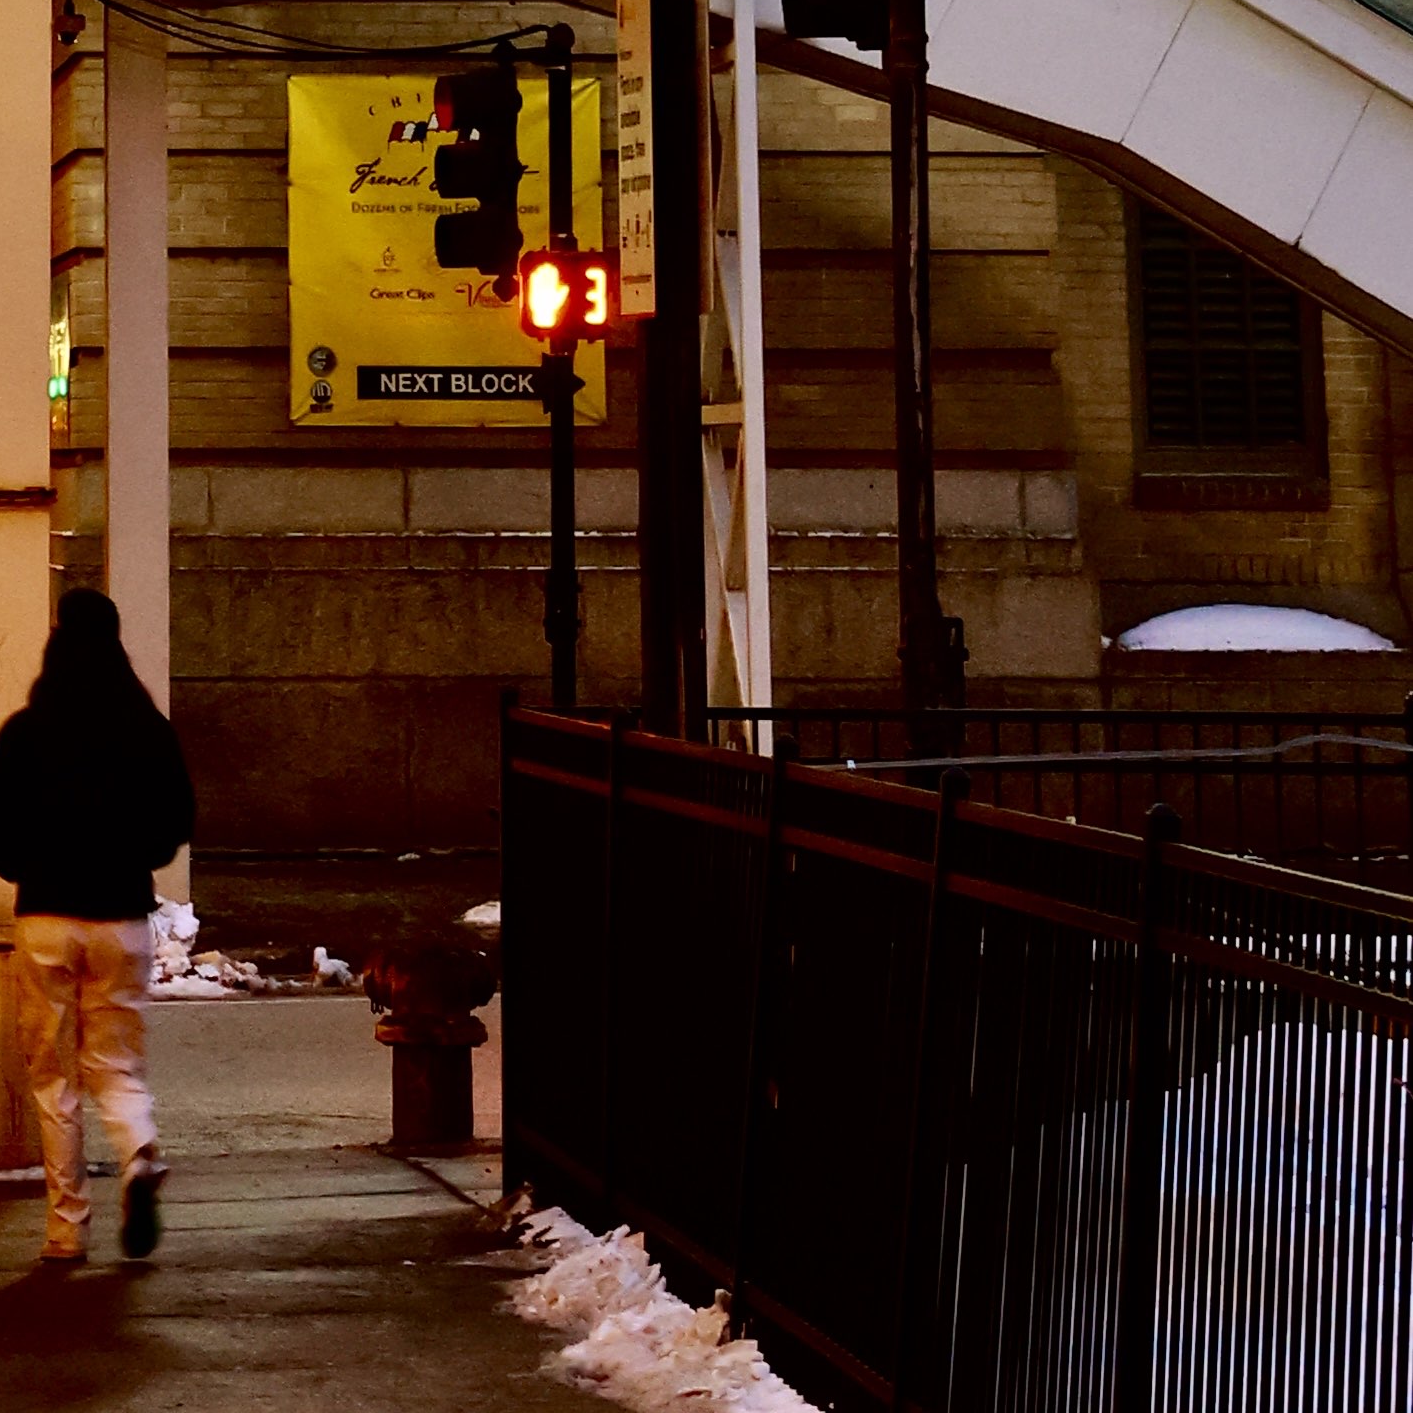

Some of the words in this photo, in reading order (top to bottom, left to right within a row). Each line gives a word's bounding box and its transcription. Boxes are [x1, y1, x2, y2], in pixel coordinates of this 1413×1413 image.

[350, 157, 428, 193] French
[584, 266, 607, 326] 3
[380, 373, 444, 393] NEXT
[451, 373, 535, 394] BLOCK
